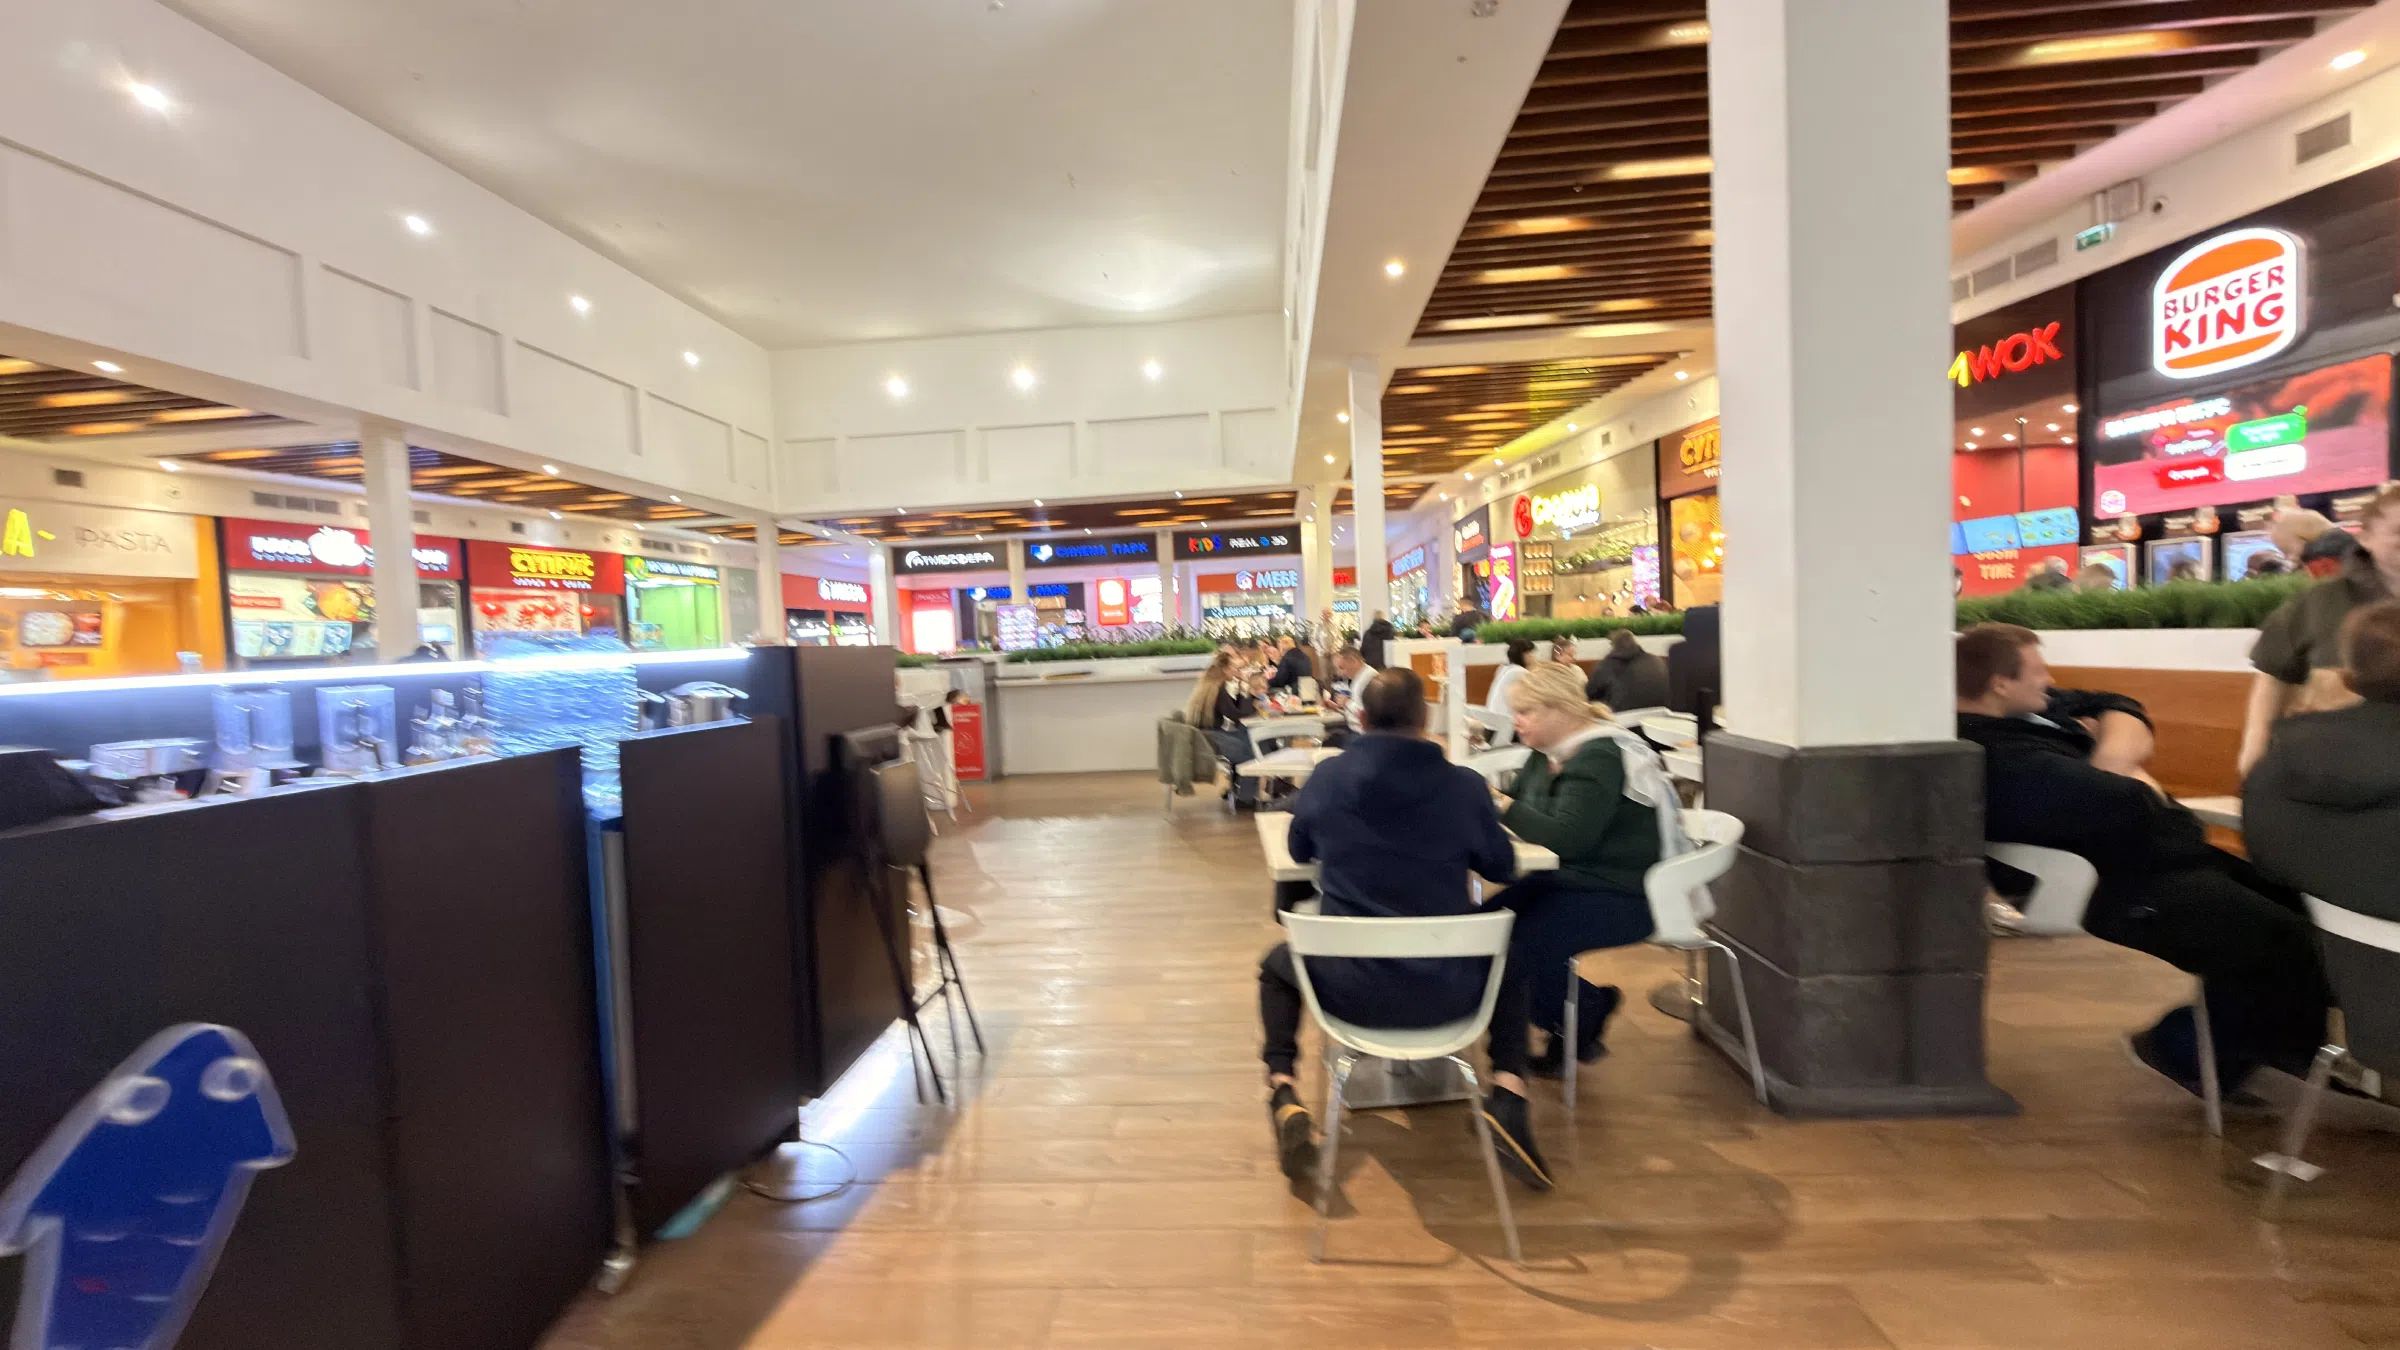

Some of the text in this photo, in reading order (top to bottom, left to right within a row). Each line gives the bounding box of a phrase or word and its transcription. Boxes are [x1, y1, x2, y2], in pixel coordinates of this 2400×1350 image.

[2164, 265, 2285, 320] BURGER
[2165, 292, 2285, 354] KING
[75, 526, 172, 554] PASTA
[1111, 542, 1149, 555] ПАРК
[1188, 535, 1223, 552] KIDS
[907, 551, 995, 567] АТМОСФЕРА
